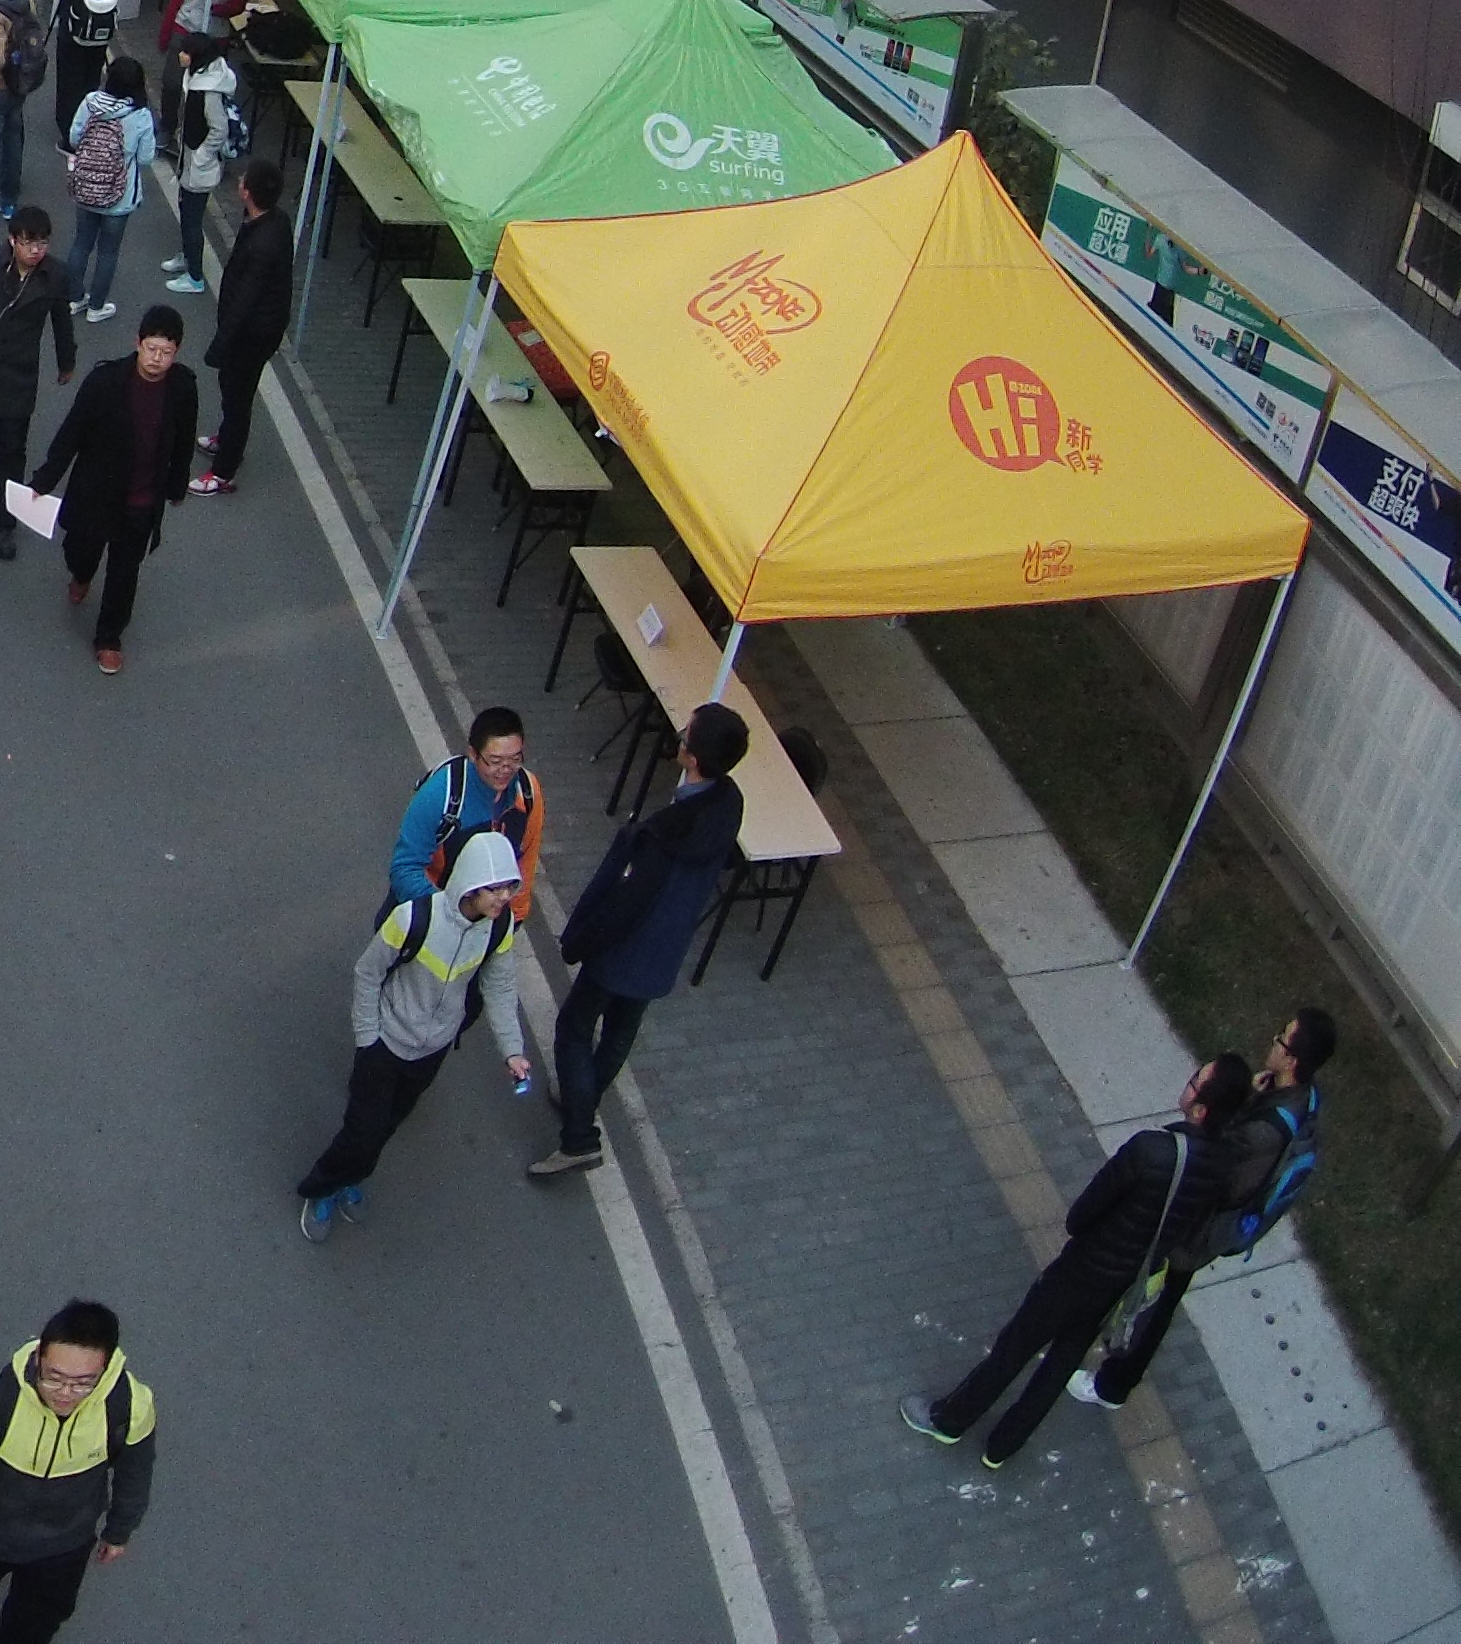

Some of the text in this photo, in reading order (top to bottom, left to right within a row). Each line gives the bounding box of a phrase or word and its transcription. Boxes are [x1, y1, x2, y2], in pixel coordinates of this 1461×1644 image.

[711, 124, 782, 167] 天翼
[709, 158, 785, 186] surfing
[1093, 206, 1131, 240] 应用
[956, 372, 1042, 458] Hi
[1066, 418, 1093, 452] 新
[1065, 450, 1104, 476] 同学
[1376, 457, 1426, 502] 支付
[1367, 484, 1422, 532] 超爽快
